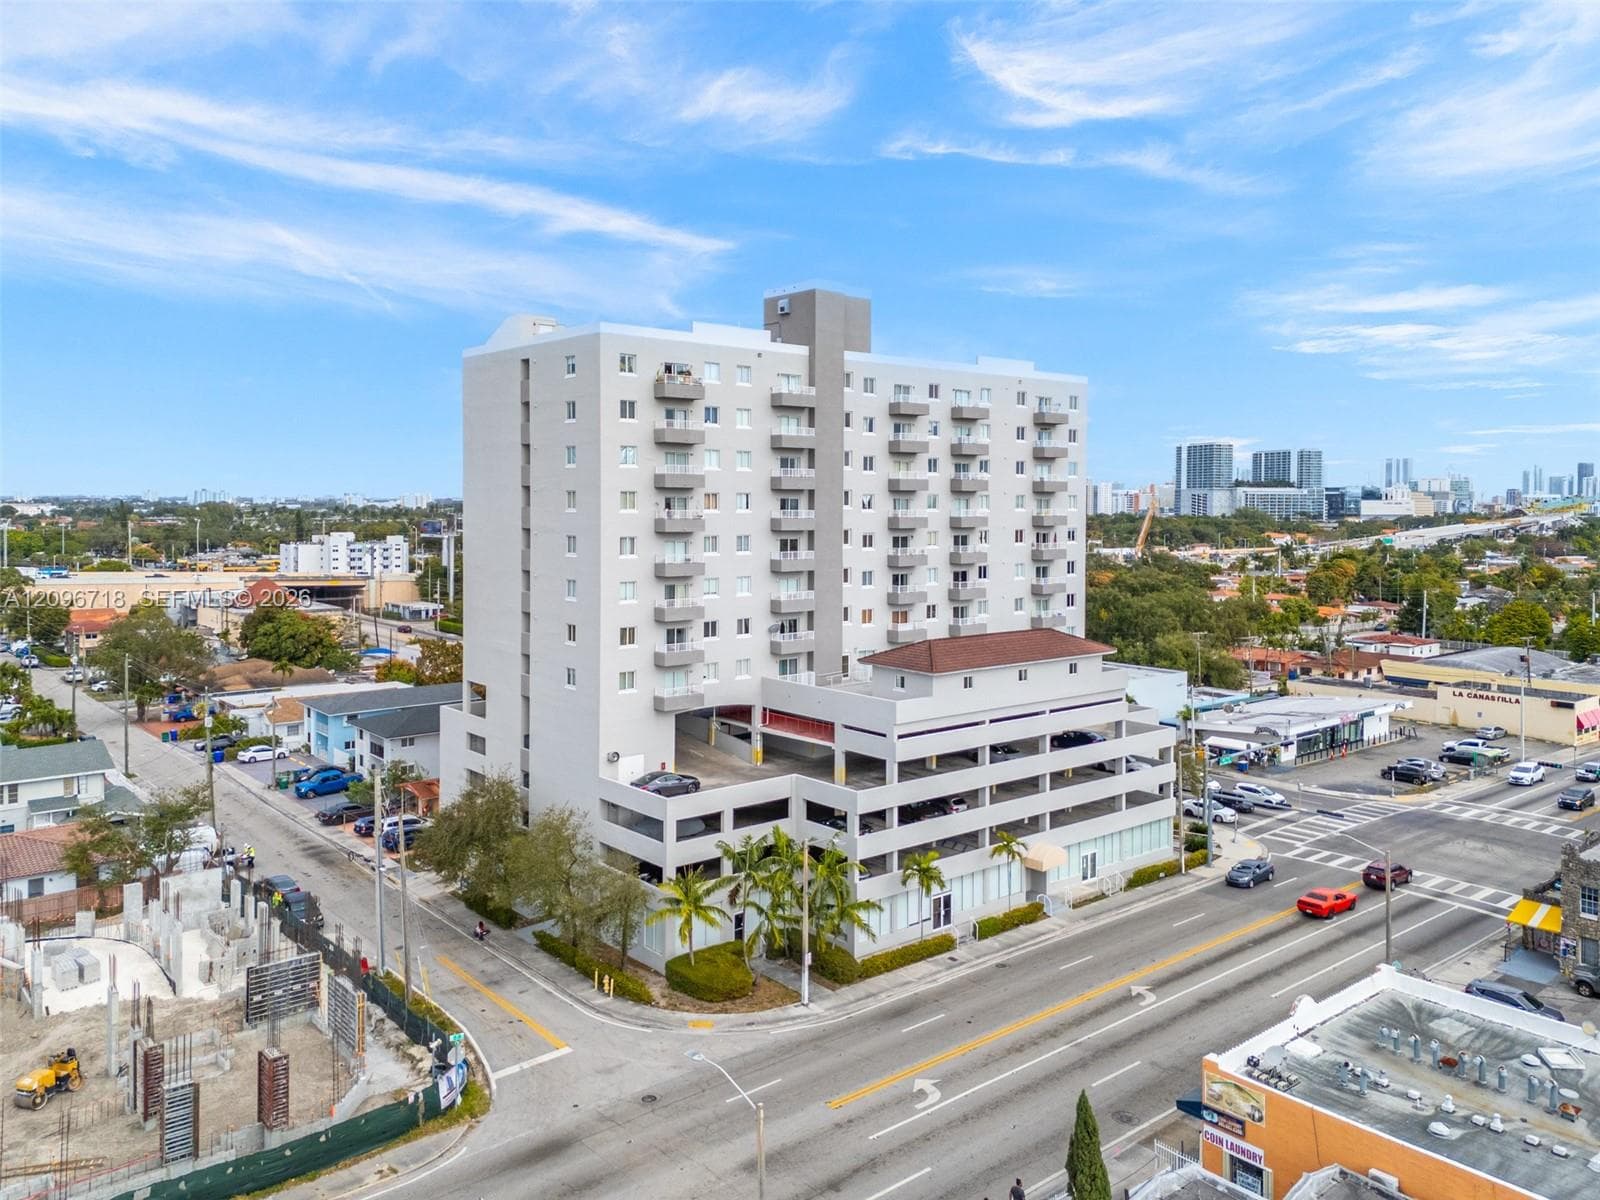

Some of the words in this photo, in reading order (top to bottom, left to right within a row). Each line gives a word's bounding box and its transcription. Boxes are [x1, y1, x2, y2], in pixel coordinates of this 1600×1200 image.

[1466, 692, 1520, 704] CANASTILLA
[1204, 1130, 1223, 1146] COIN
[1225, 1140, 1263, 1164] LAUNDRY
